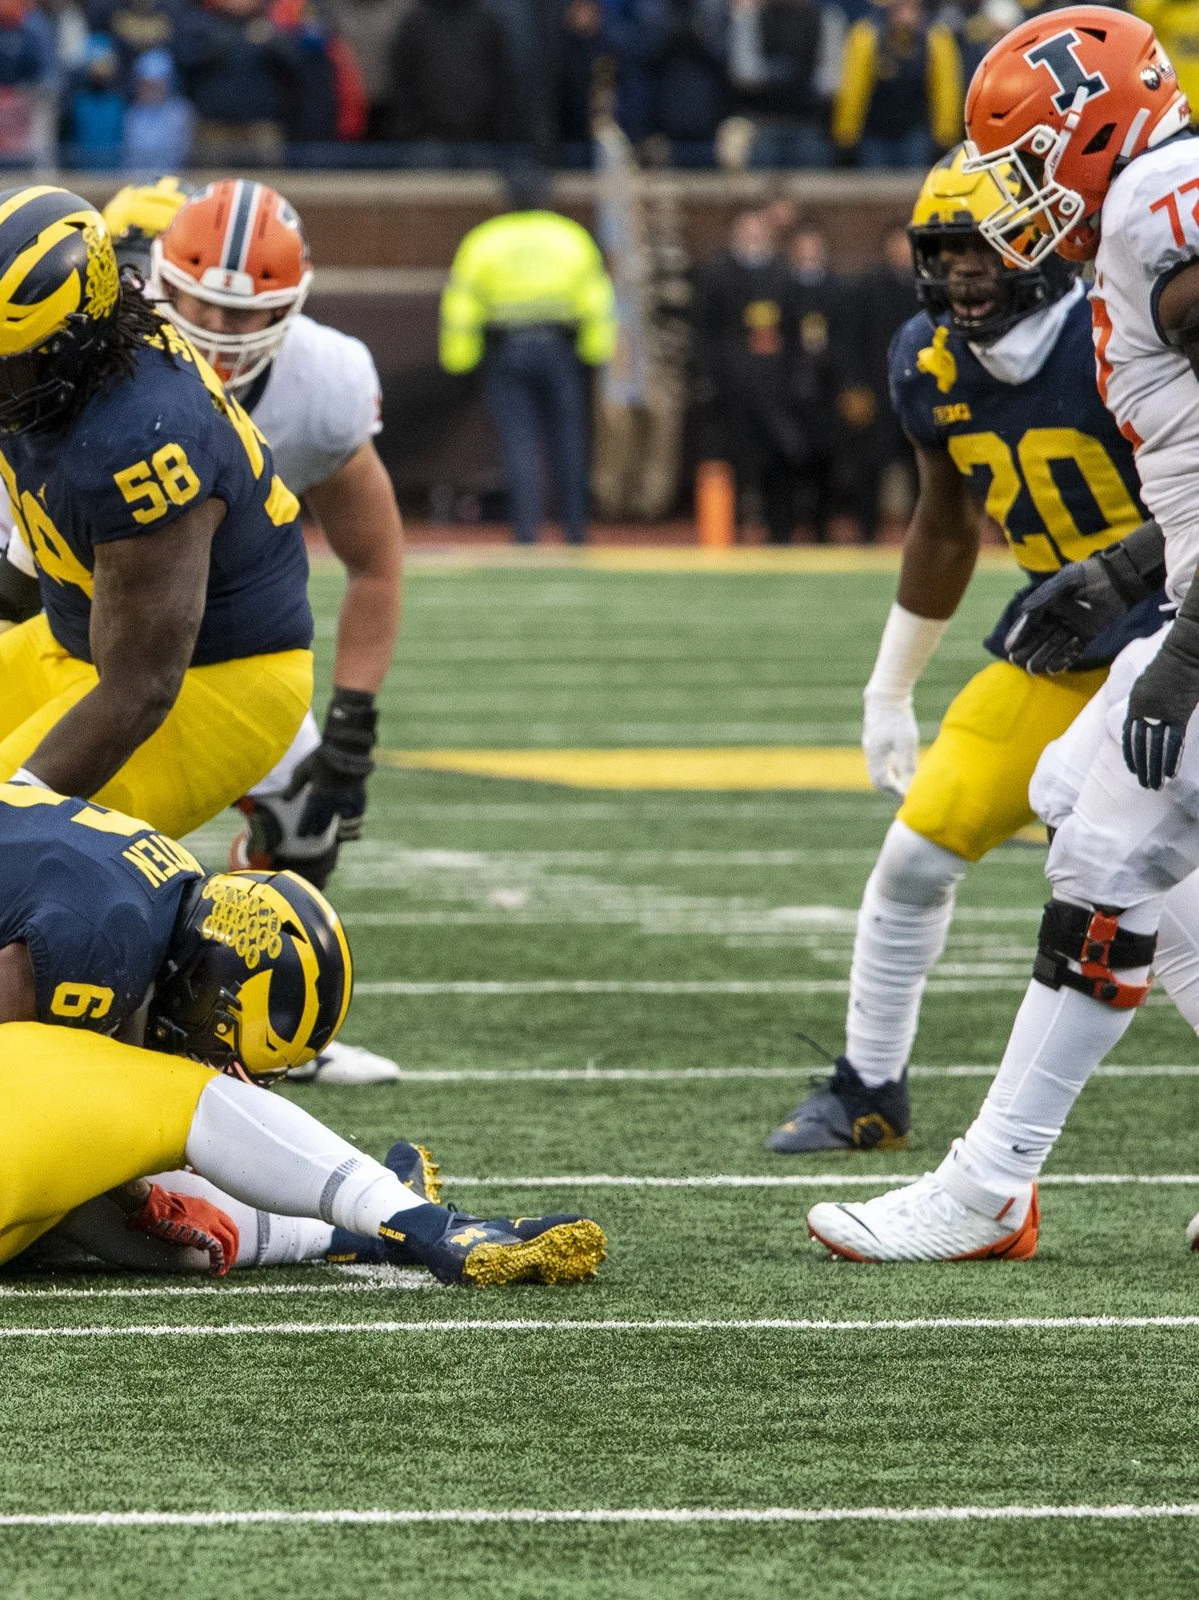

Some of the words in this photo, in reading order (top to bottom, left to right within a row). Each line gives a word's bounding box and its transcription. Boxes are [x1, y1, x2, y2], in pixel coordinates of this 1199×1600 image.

[1023, 28, 1110, 117] I
[113, 442, 200, 524] 58
[947, 427, 1145, 573] 20
